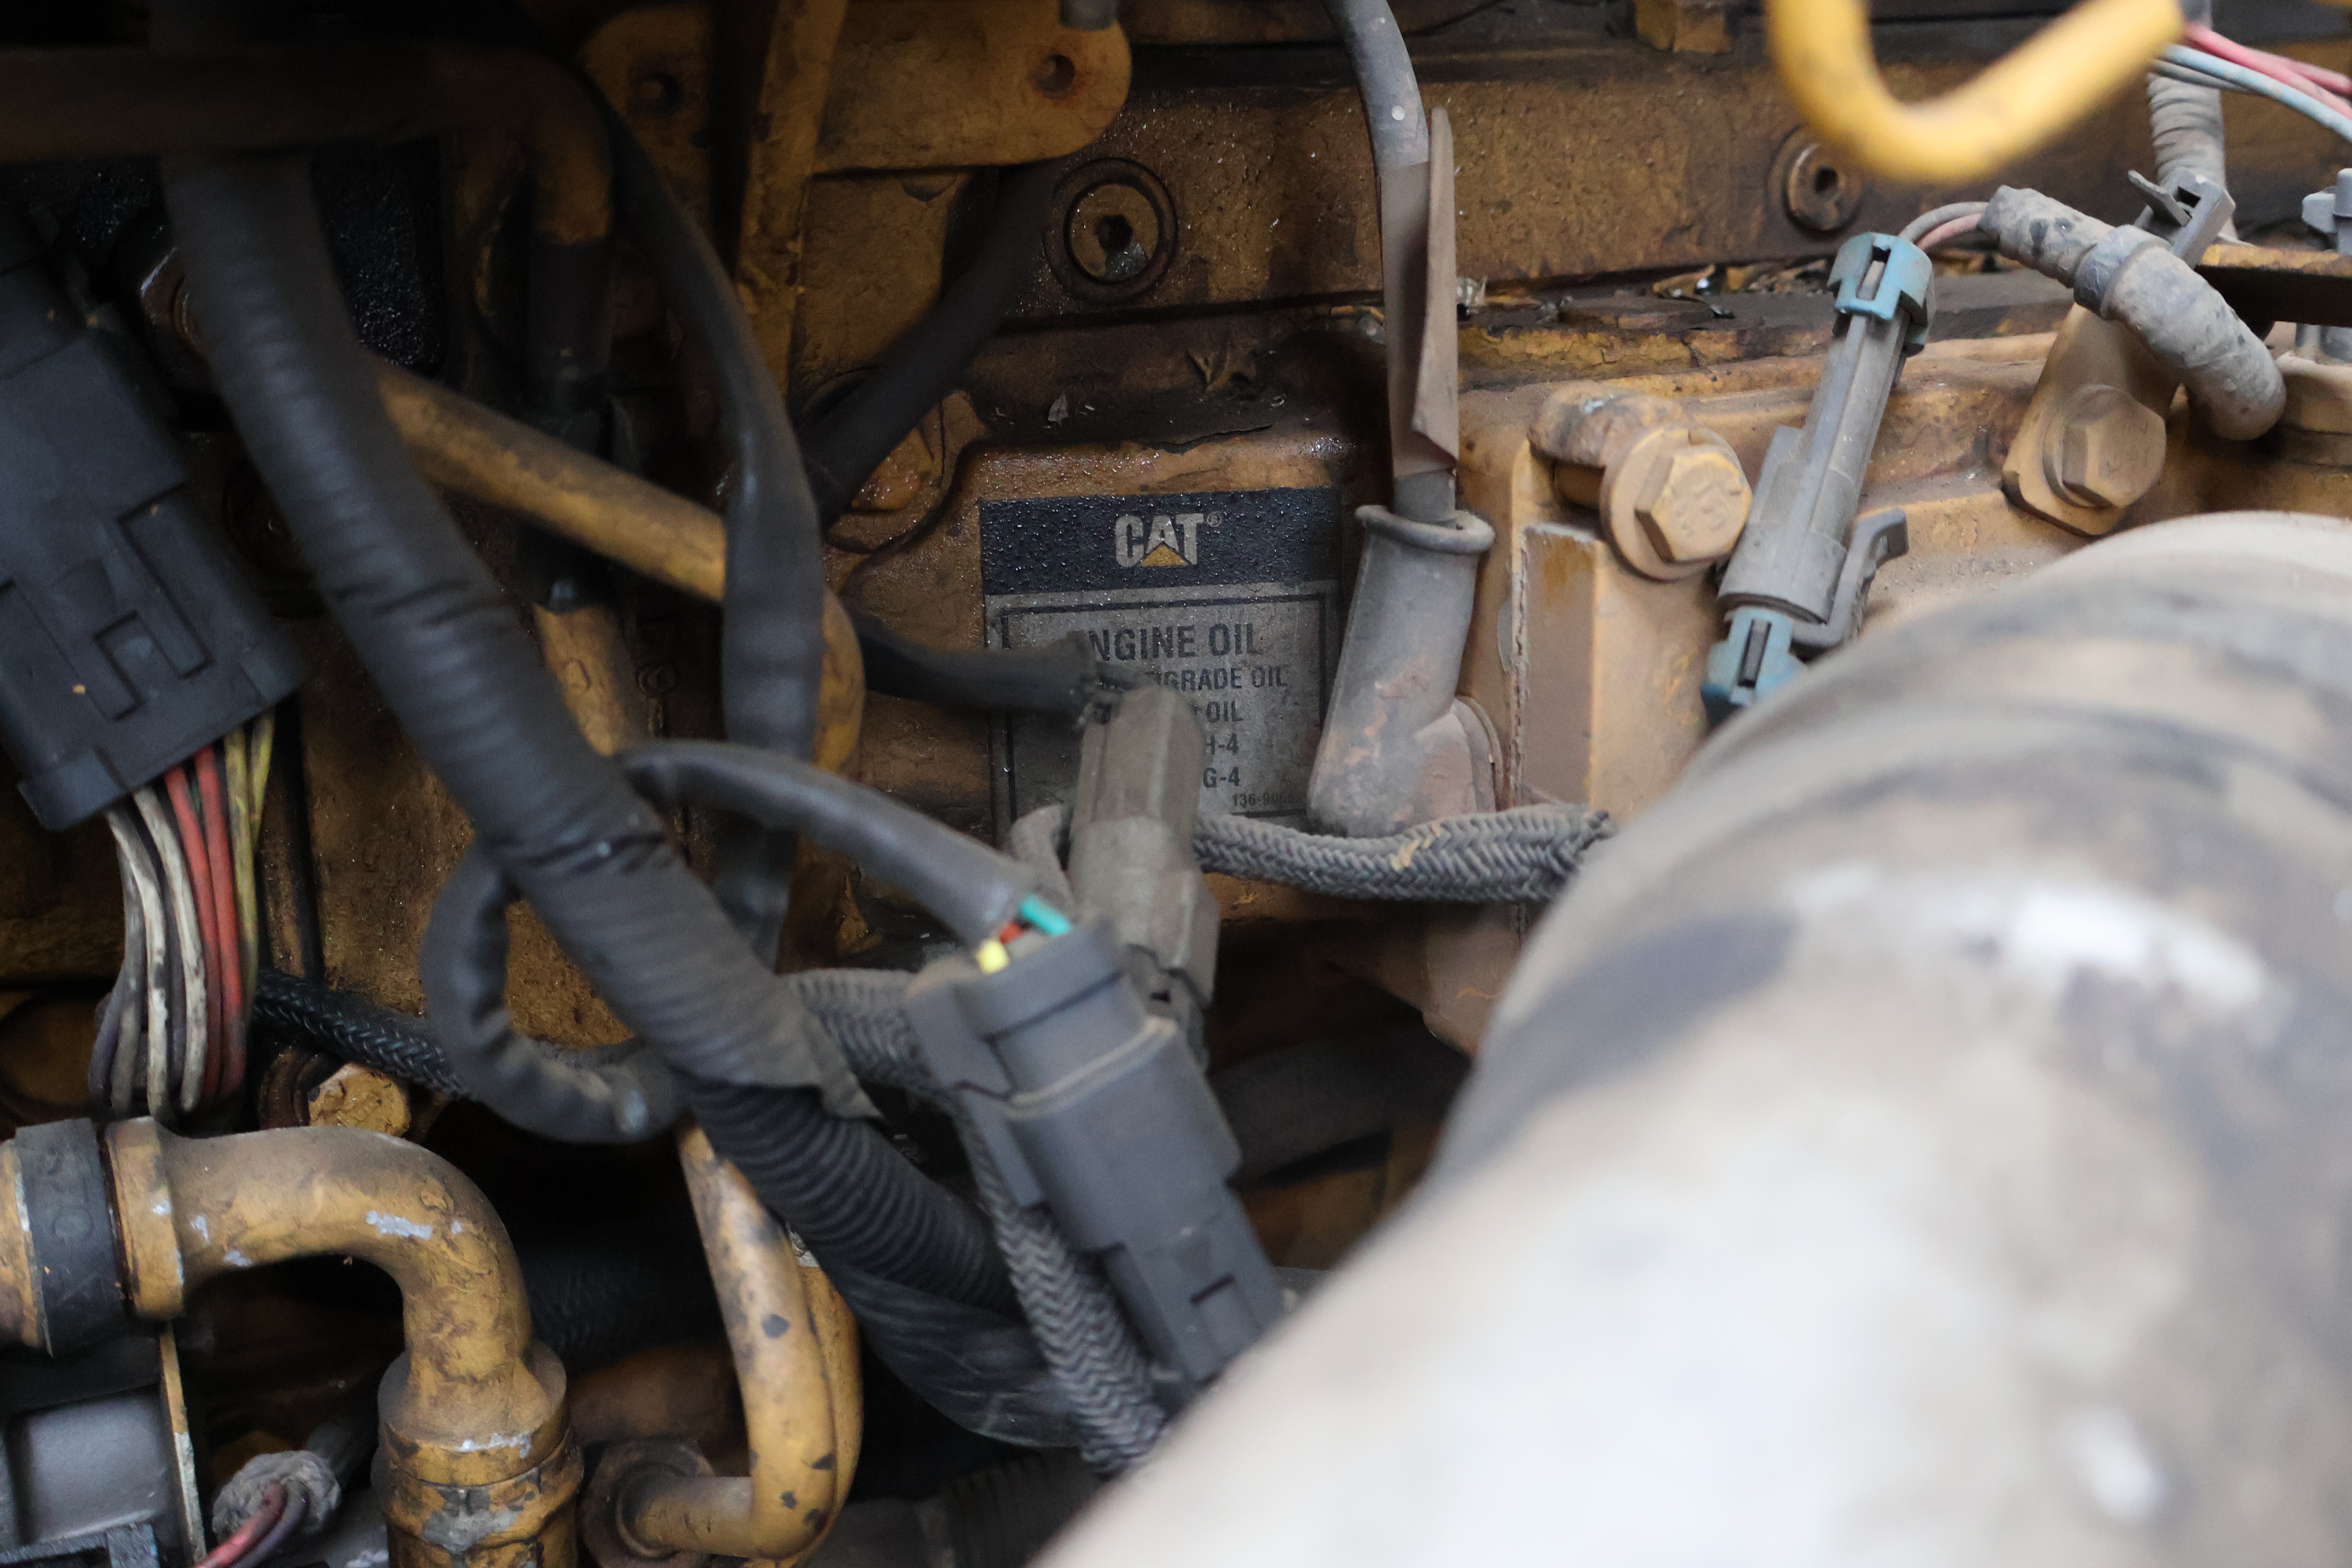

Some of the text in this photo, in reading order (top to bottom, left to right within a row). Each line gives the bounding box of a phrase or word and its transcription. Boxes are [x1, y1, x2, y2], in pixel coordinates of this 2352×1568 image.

[1088, 622, 1263, 661] NGINE OIL
[1252, 667, 1288, 688] OIL
[1207, 701, 1243, 723] OIL
[1203, 732, 1239, 756] H-4
[1203, 766, 1240, 788] G-4
